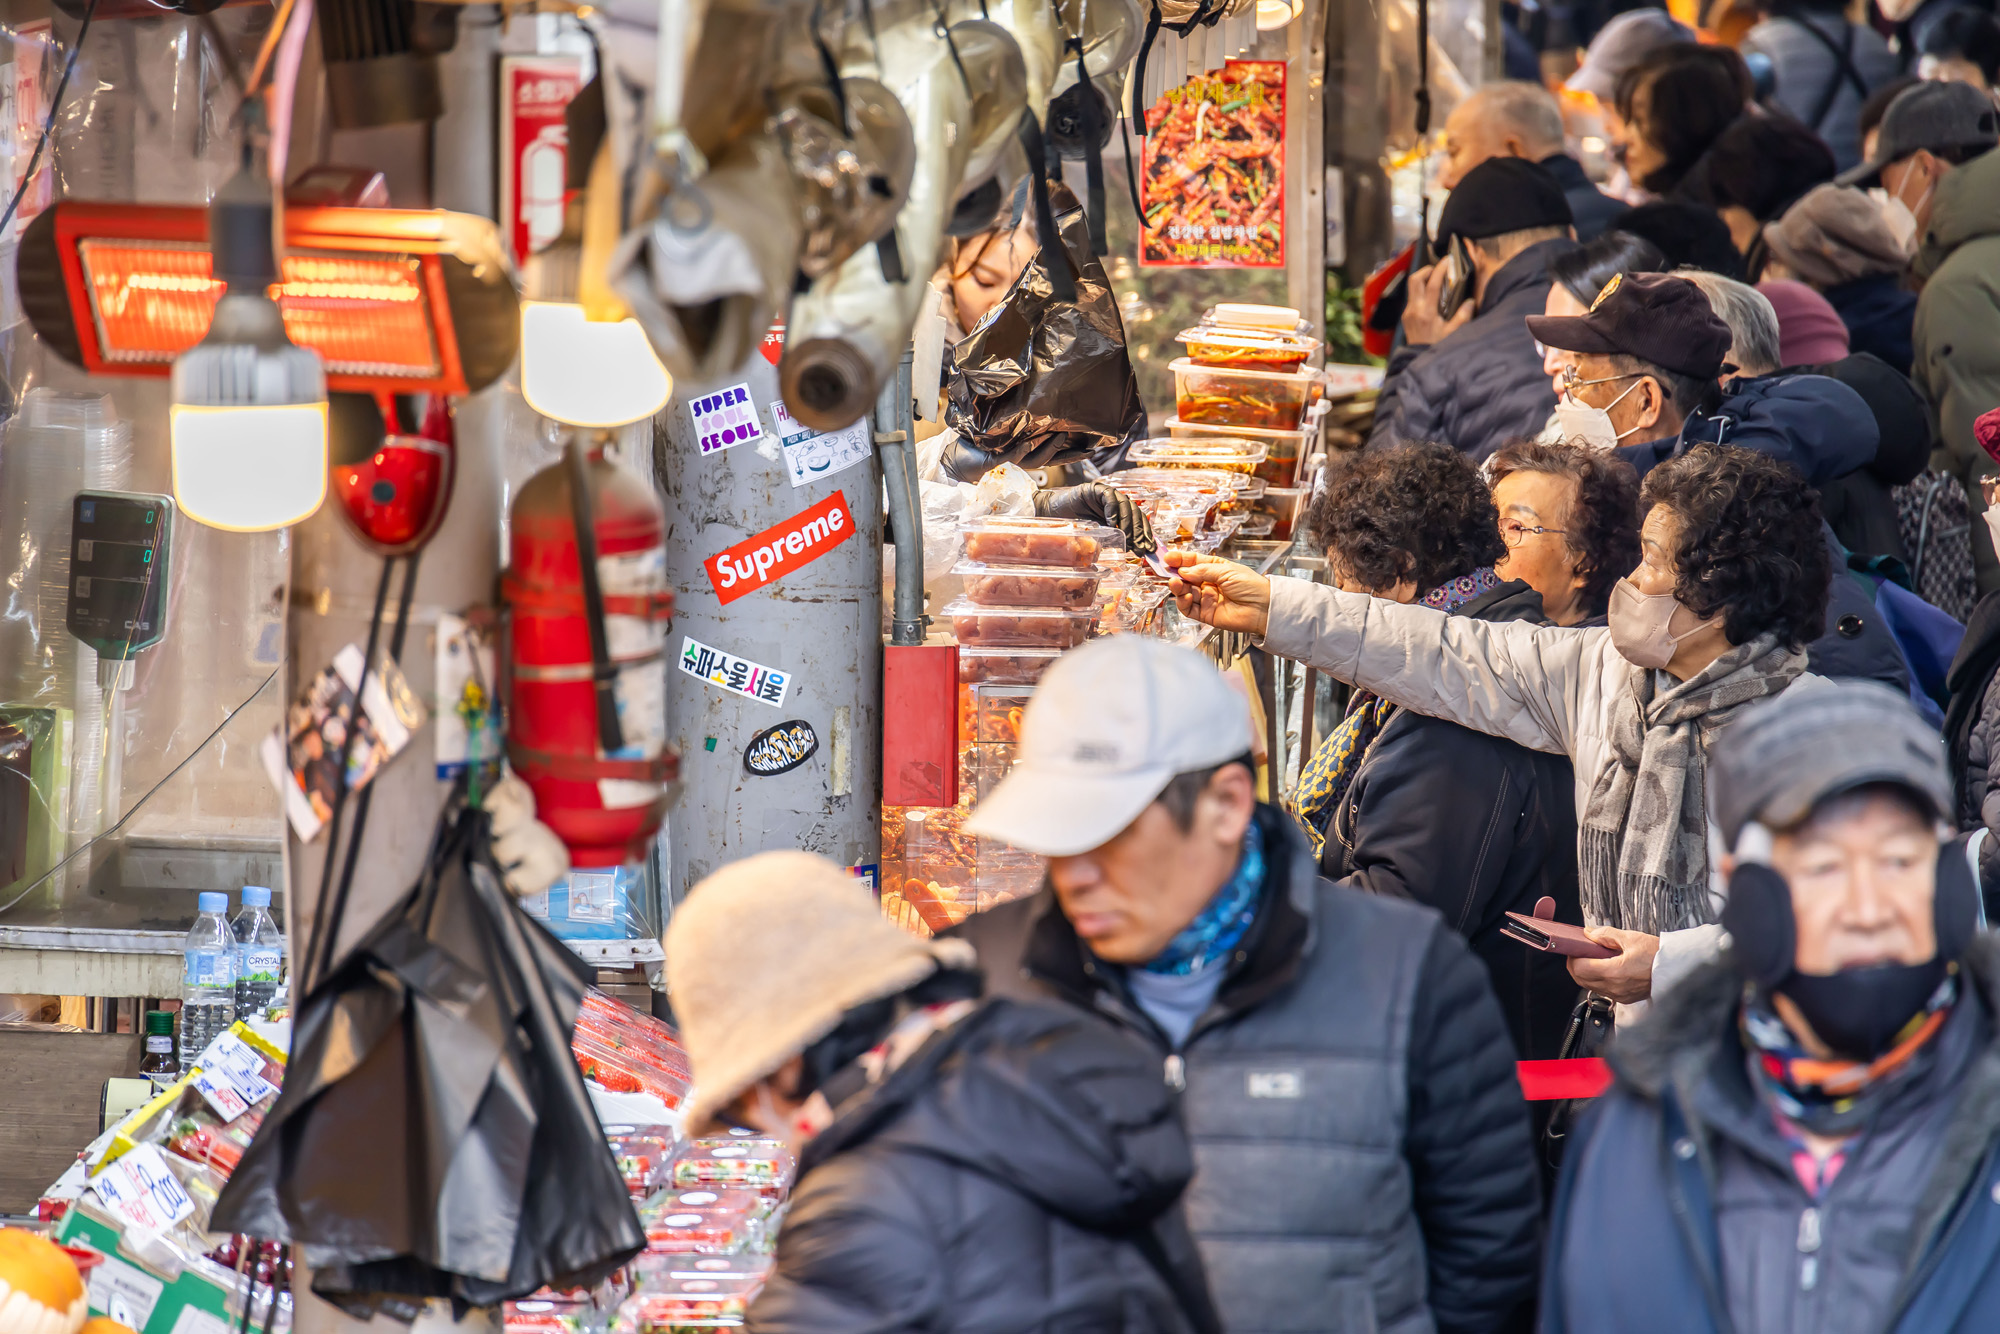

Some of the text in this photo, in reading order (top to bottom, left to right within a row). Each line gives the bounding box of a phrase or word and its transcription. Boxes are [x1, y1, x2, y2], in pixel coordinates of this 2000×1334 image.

[693, 387, 749, 417] SUPER
[701, 409, 749, 434] SOUL
[701, 422, 760, 452] SEOUL
[716, 507, 844, 588] Supreme
[124, 620, 150, 631] CAS
[248, 957, 280, 965] CRYSTAL
